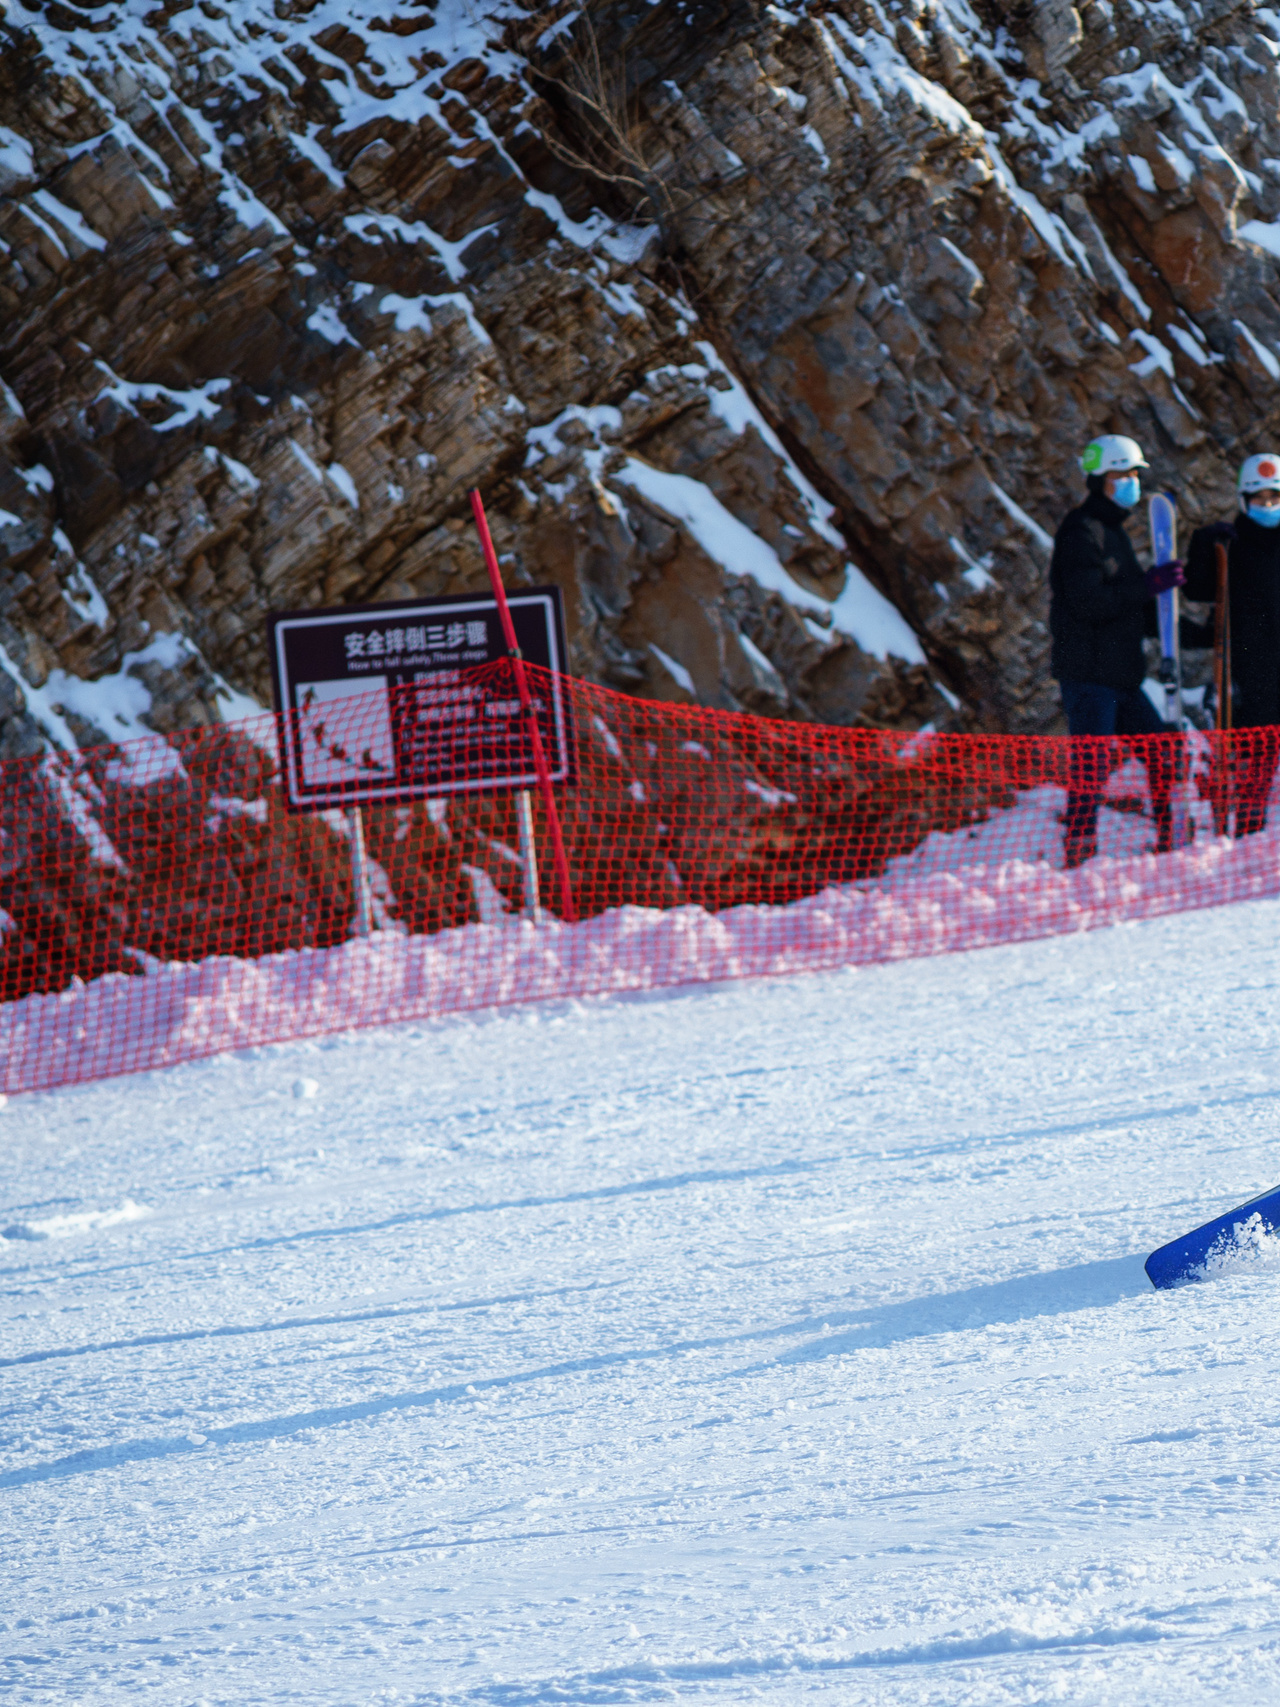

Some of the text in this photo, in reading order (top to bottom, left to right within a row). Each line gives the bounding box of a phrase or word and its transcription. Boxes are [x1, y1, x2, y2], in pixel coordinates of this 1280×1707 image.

[343, 620, 488, 658] 安全摔倒三步骤
[347, 660, 370, 672] How
[371, 659, 382, 670] to
